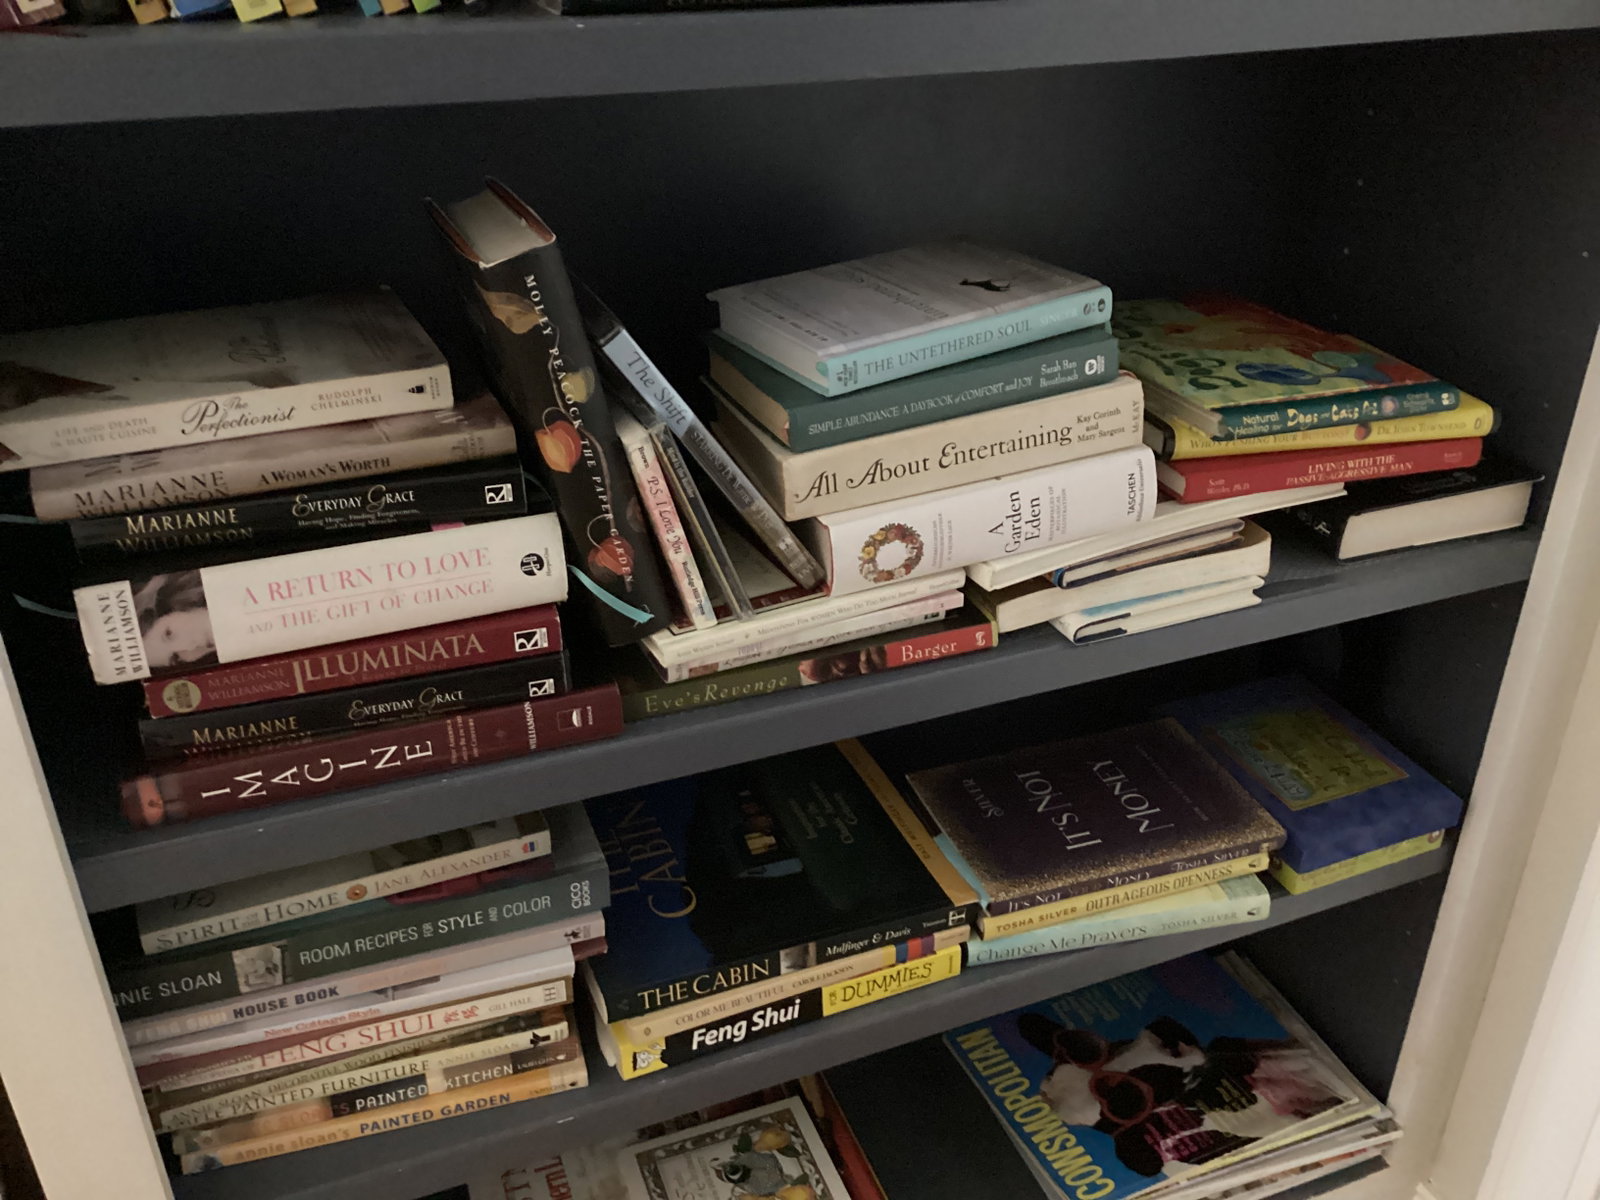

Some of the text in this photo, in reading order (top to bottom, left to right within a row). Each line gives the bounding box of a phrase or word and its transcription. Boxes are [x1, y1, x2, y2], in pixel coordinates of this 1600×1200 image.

[522, 273, 585, 430] MOLLY PEACOCK
[863, 358, 896, 377] THE
[897, 329, 994, 368] UNTETHERED
[998, 318, 1034, 340] SOUL
[1040, 362, 1061, 376] Sarah
[1062, 359, 1078, 372] Ban
[317, 386, 372, 401] RUDOLPH
[625, 350, 690, 426] The Shift
[180, 400, 296, 436] Perfectionist
[808, 417, 843, 436] SIMPLE
[844, 405, 900, 428] ABUNDANCE
[961, 382, 1005, 402] COMFORT
[1016, 375, 1034, 390] JOY
[1077, 406, 1122, 425] Kay Corinth
[1242, 411, 1280, 425] Natural
[1287, 403, 1360, 430] Dogs Cats
[1077, 432, 1095, 444] Mary
[1085, 421, 1100, 432] and
[337, 456, 390, 474] WORTH
[793, 424, 1074, 504] All About Entertaining
[1308, 453, 1396, 475] LIVING WITH THE
[1388, 461, 1415, 474] MAN
[74, 470, 226, 507] MARIANNE
[292, 494, 362, 517] EVERYDAY
[1127, 472, 1136, 516] TASCHEN
[126, 508, 238, 535] MARIANNE
[581, 437, 598, 469] THE
[610, 528, 636, 585] GARDEN
[659, 509, 676, 535] Love
[1004, 490, 1021, 553] Garden
[1024, 496, 1041, 542] Eden
[667, 533, 683, 555] You
[987, 521, 1005, 536] A
[242, 546, 492, 606] A RETURN TO LOVE
[279, 606, 321, 629] THE
[326, 596, 373, 622] GIFT
[379, 594, 407, 611] OF
[412, 578, 495, 606] CHANGE
[96, 592, 127, 677] MARIANNE
[115, 589, 144, 675] WILLIAMSON
[292, 632, 487, 694] ILLUMINATA
[902, 639, 958, 663] Barger
[207, 668, 287, 688] MARIANNE
[207, 680, 292, 701] WILLIAMSON
[644, 673, 791, 714] Eve's Revenge
[348, 698, 415, 721] EVERYDAY
[523, 701, 537, 750] WILLIAMSON
[192, 715, 299, 745] MARIANNE
[201, 740, 434, 800] IMAGINE
[1015, 769, 1103, 851] IT'S NOT
[1090, 759, 1176, 834] MONEY
[374, 848, 512, 893] JANE ALEXANDER
[263, 890, 341, 922] HOME
[1085, 865, 1234, 913] OUTRAGEOUS OPENNESS
[156, 916, 240, 949] SPIRIT
[300, 941, 352, 967] ROOM
[353, 926, 420, 953] RECIPES
[437, 910, 485, 934] STYLE
[502, 894, 552, 919] COLOR
[996, 906, 1079, 933] TOSHA SILVER
[1159, 910, 1239, 932] TOSHA SILVER
[825, 926, 912, 958] Mulfinger & Davis
[976, 924, 1149, 964] Change Me Prayers
[159, 970, 224, 998] SLOAN
[637, 957, 771, 1011] THE CABIN
[841, 961, 934, 1003] DUMMIES
[232, 985, 340, 1019] HOUSE BOOK
[264, 1006, 382, 1039] New Cottage Style
[691, 998, 801, 1051] Feng Shui
[259, 1033, 348, 1068] FENG
[357, 1012, 435, 1046] SHUI
[437, 1041, 521, 1068] ANNIE SLOAN
[231, 1085, 315, 1117] PAINTED
[321, 1059, 430, 1096] FURNITURE
[445, 1063, 515, 1090] KITCHEN
[355, 1084, 429, 1111] PAINTED
[359, 1091, 511, 1136] PAINTED GARDEN
[290, 1127, 351, 1149] sloan's
